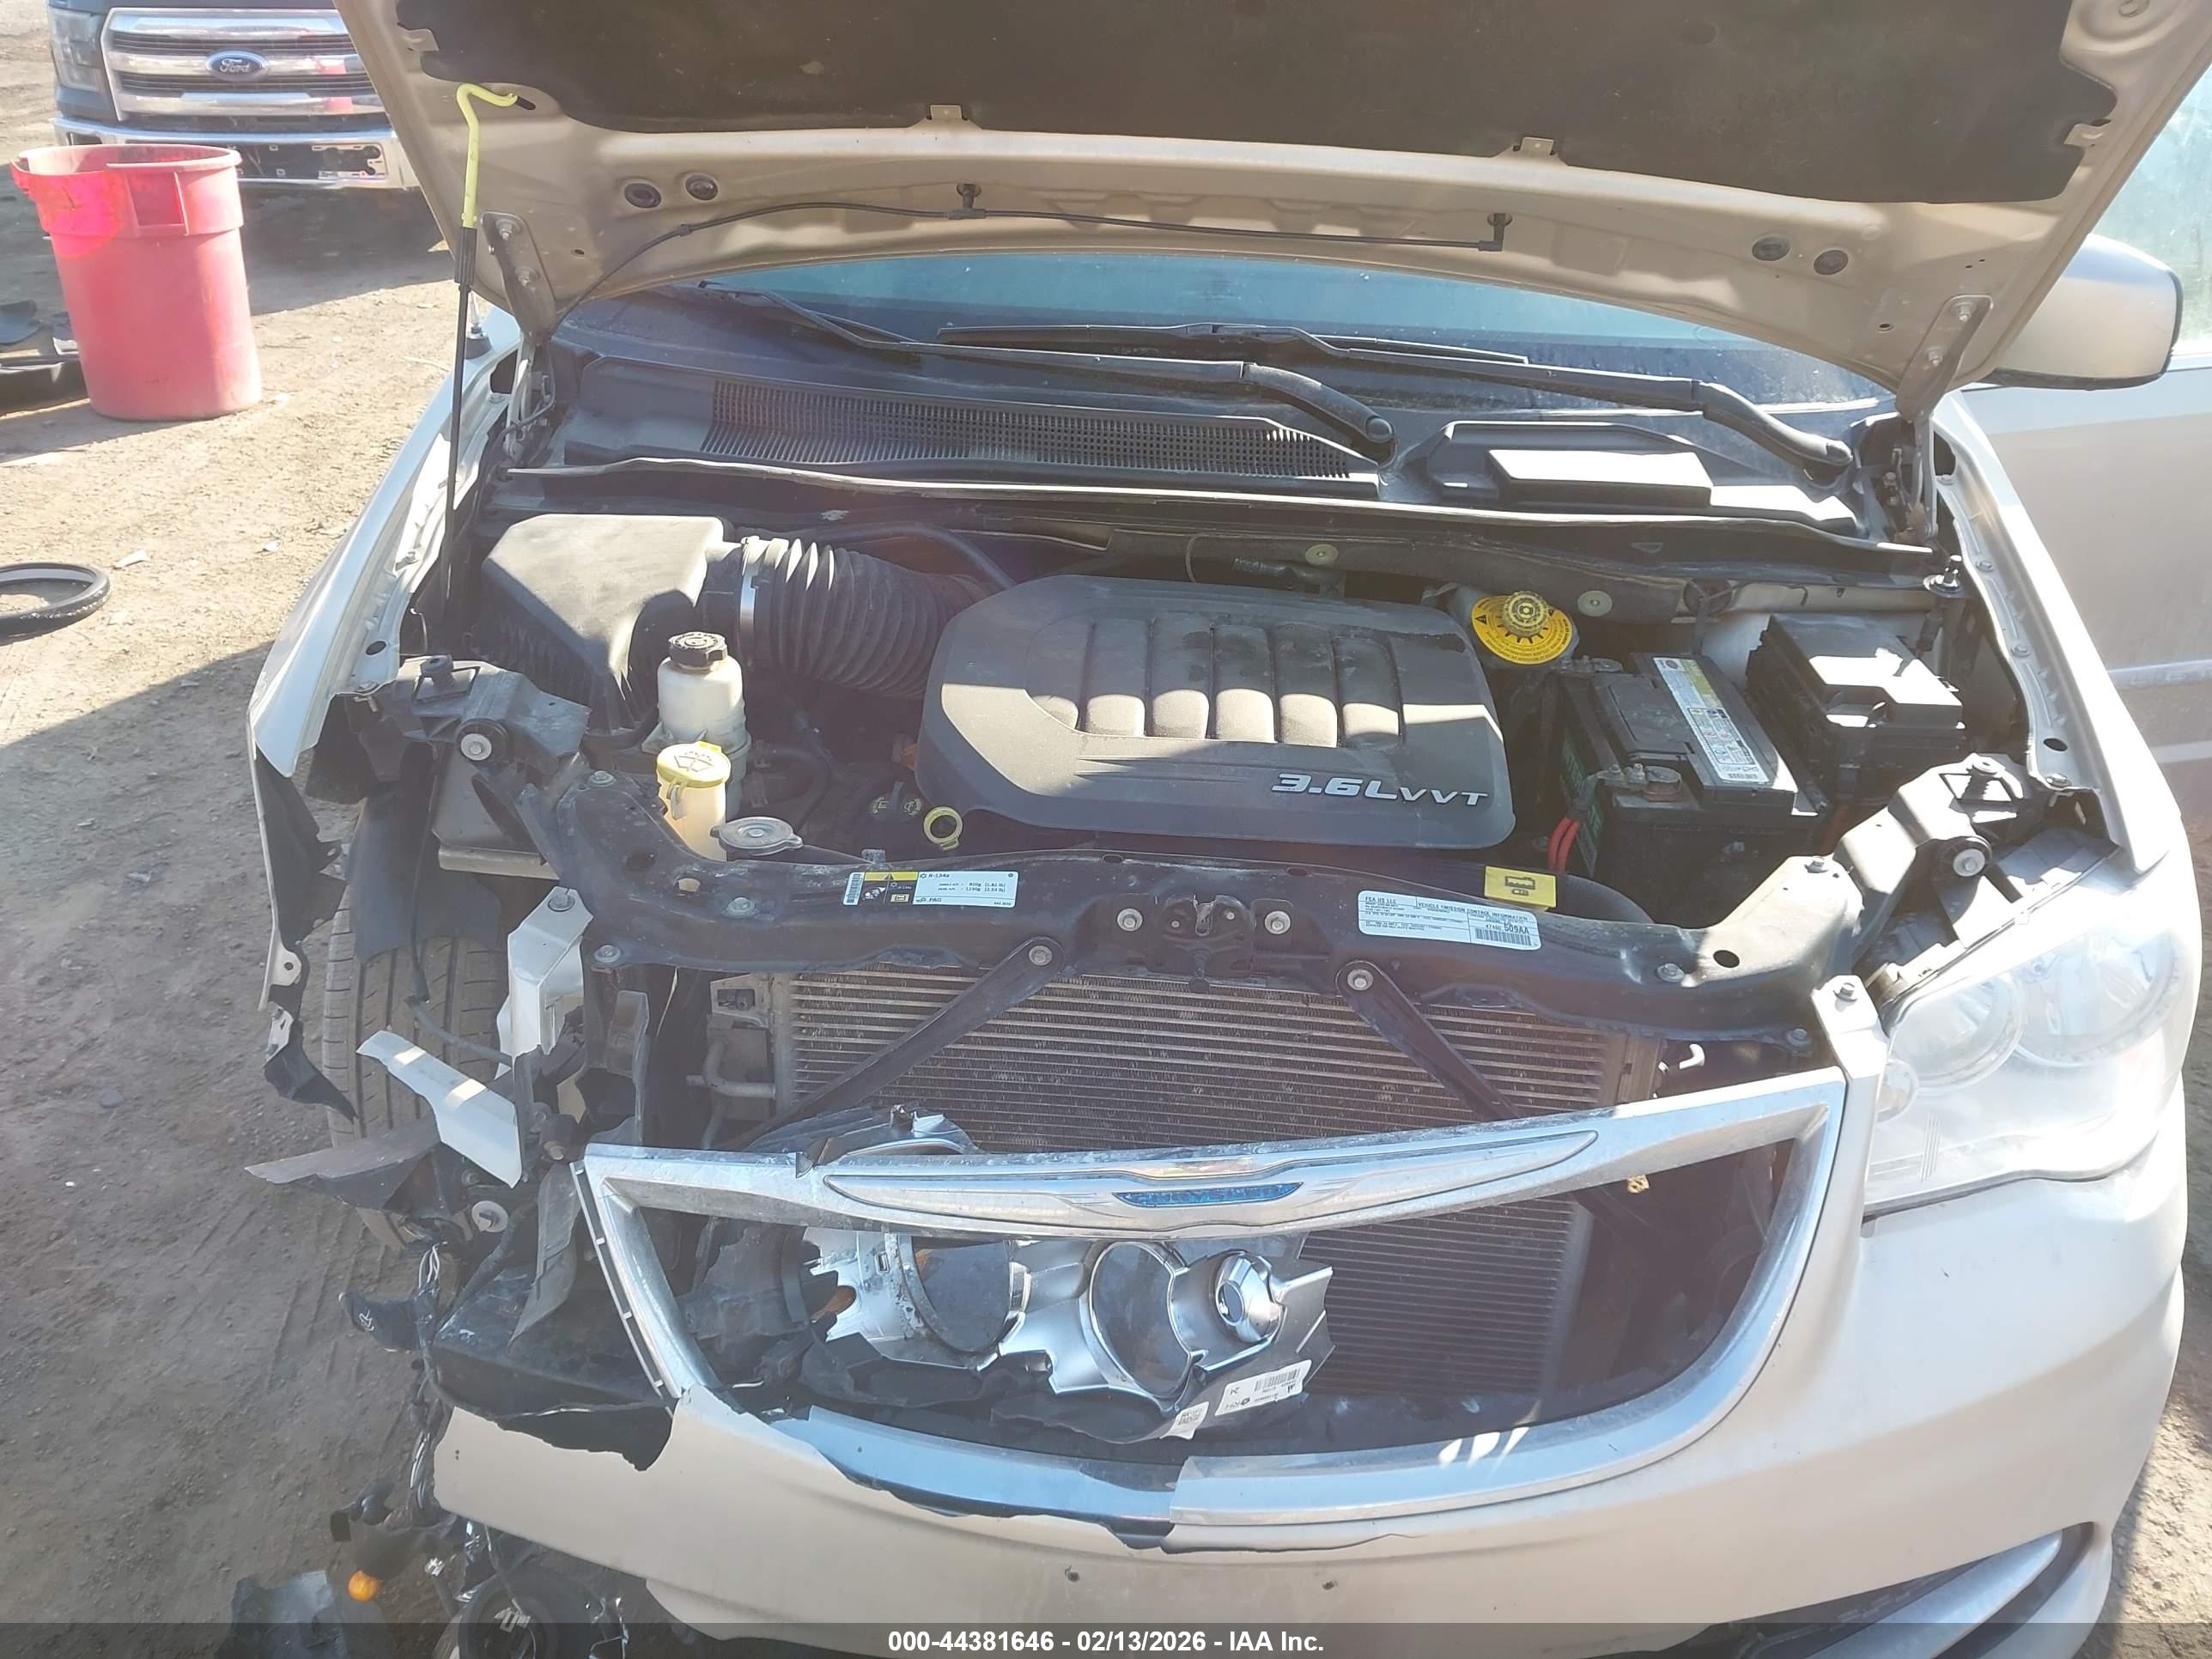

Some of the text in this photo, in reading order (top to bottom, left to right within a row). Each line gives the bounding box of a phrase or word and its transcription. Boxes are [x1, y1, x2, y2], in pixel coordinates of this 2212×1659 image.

[219, 58, 250, 73] Ford
[1440, 904, 1466, 913] EMISSION
[1492, 912, 1528, 921] INFORMATION
